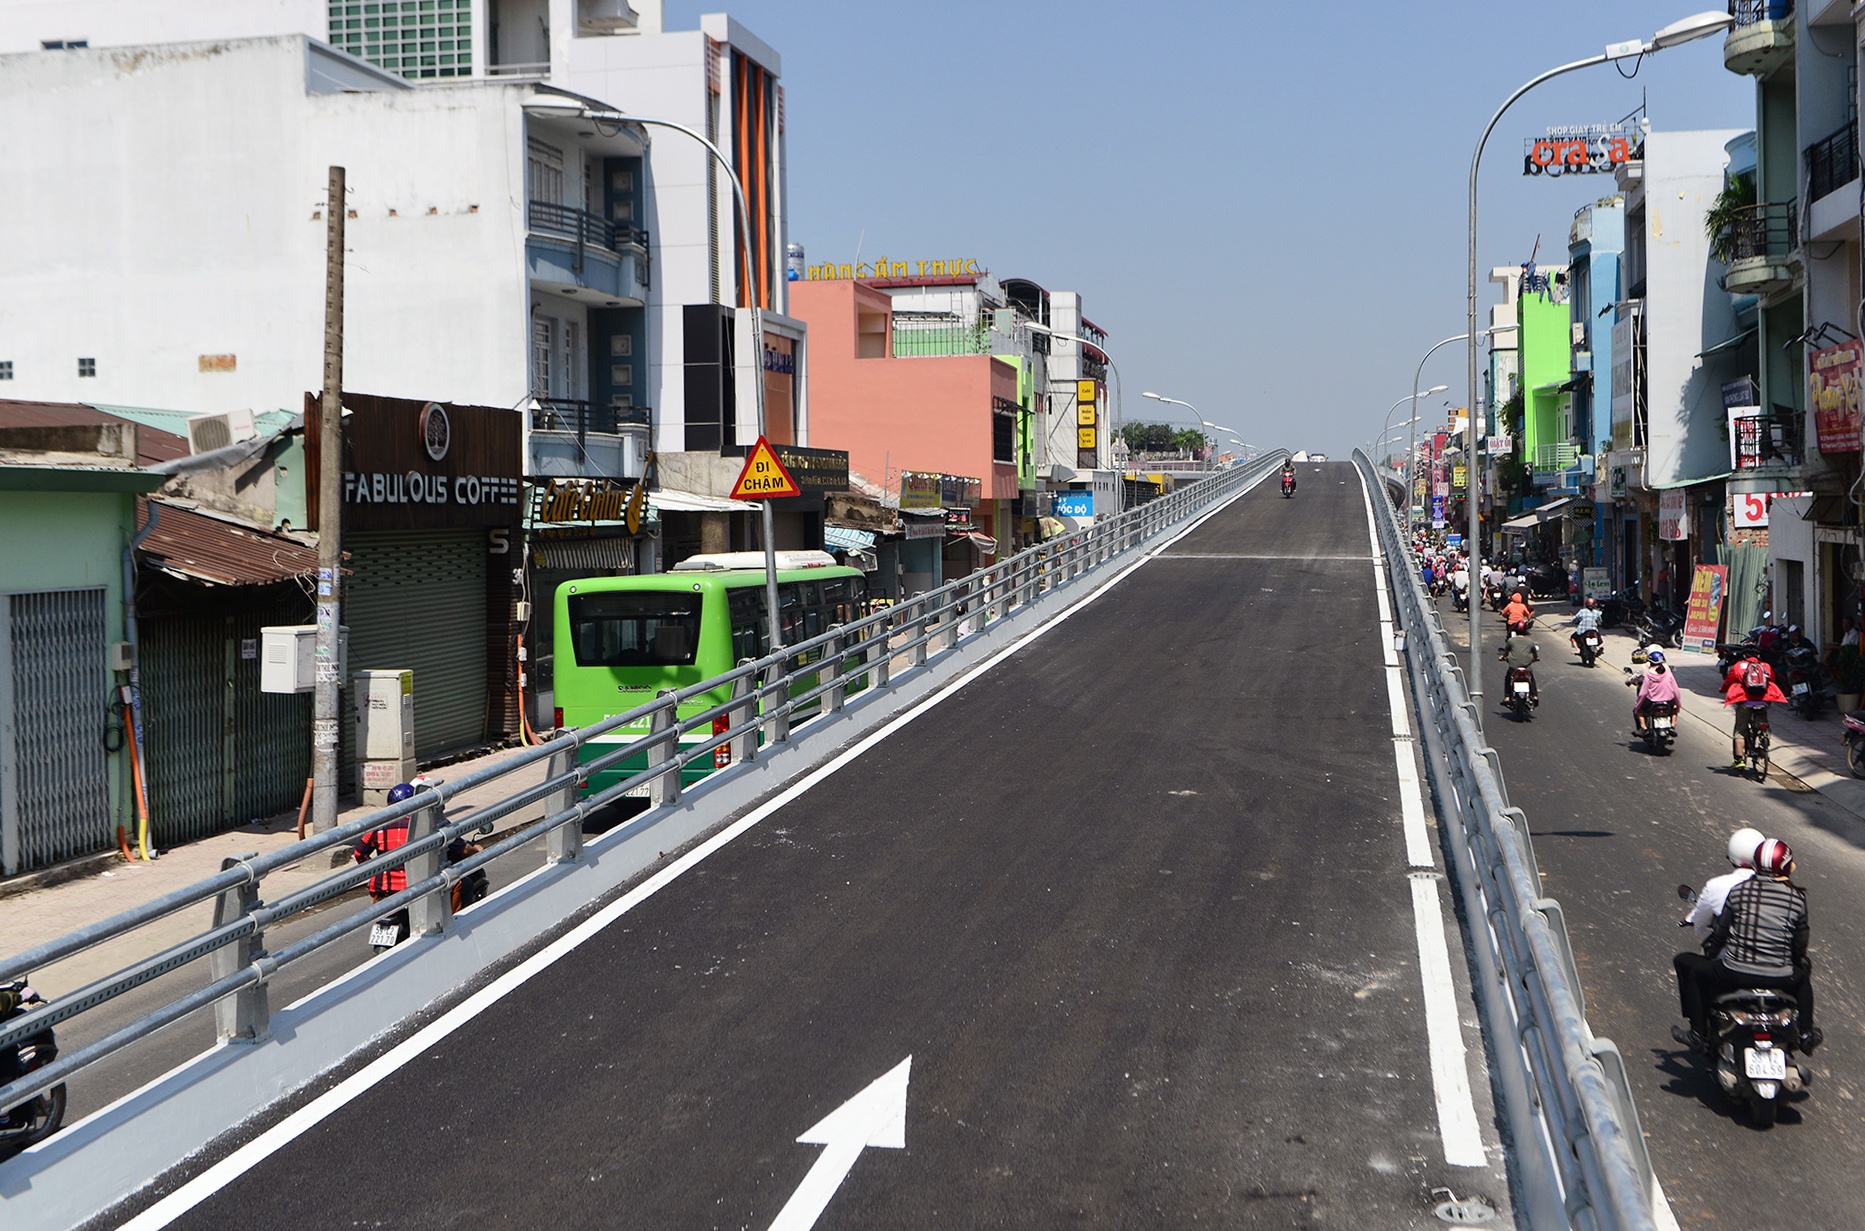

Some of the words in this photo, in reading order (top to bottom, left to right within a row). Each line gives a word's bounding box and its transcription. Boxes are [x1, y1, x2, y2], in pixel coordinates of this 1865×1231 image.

[1546, 125, 1567, 136] SHOP
[1610, 123, 1622, 132] EM
[808, 261, 866, 281] HÀNG
[876, 256, 907, 278] ẨM
[916, 258, 977, 278] THỰC
[756, 461, 770, 473] ĐI
[346, 470, 448, 504] FABULOUS
[455, 475, 518, 505] COFFEE
[744, 475, 784, 491] CHẬM
[617, 684, 652, 693] SAMCO
